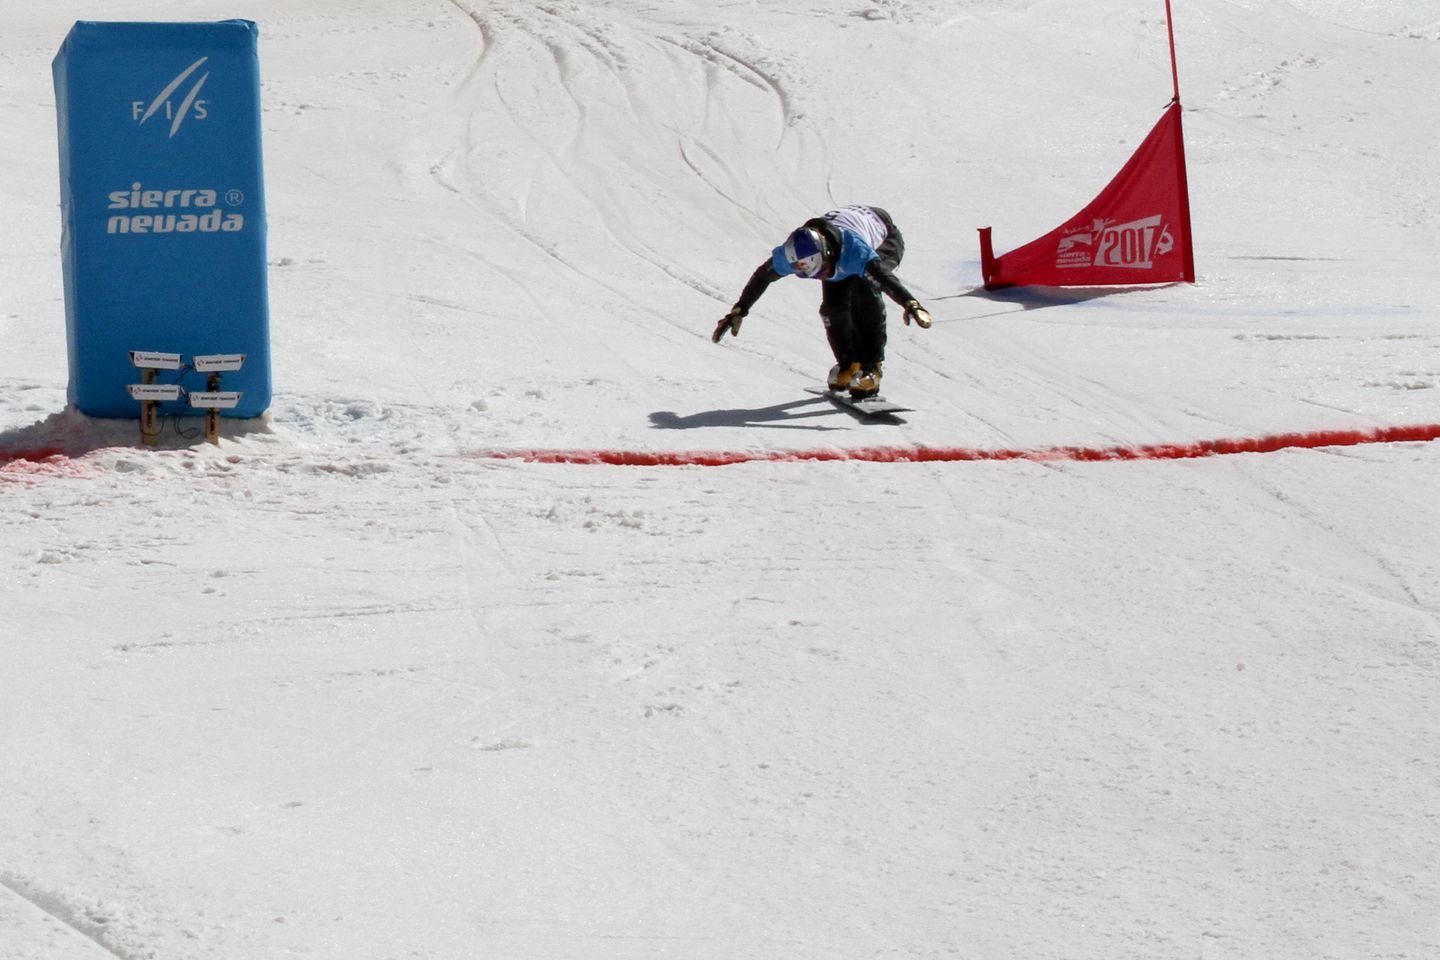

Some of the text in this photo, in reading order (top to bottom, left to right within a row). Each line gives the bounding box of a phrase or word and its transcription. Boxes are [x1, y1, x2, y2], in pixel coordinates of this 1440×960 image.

[108, 182, 217, 209] sierra
[107, 209, 244, 234] nevada
[1103, 226, 1160, 265] 2017
